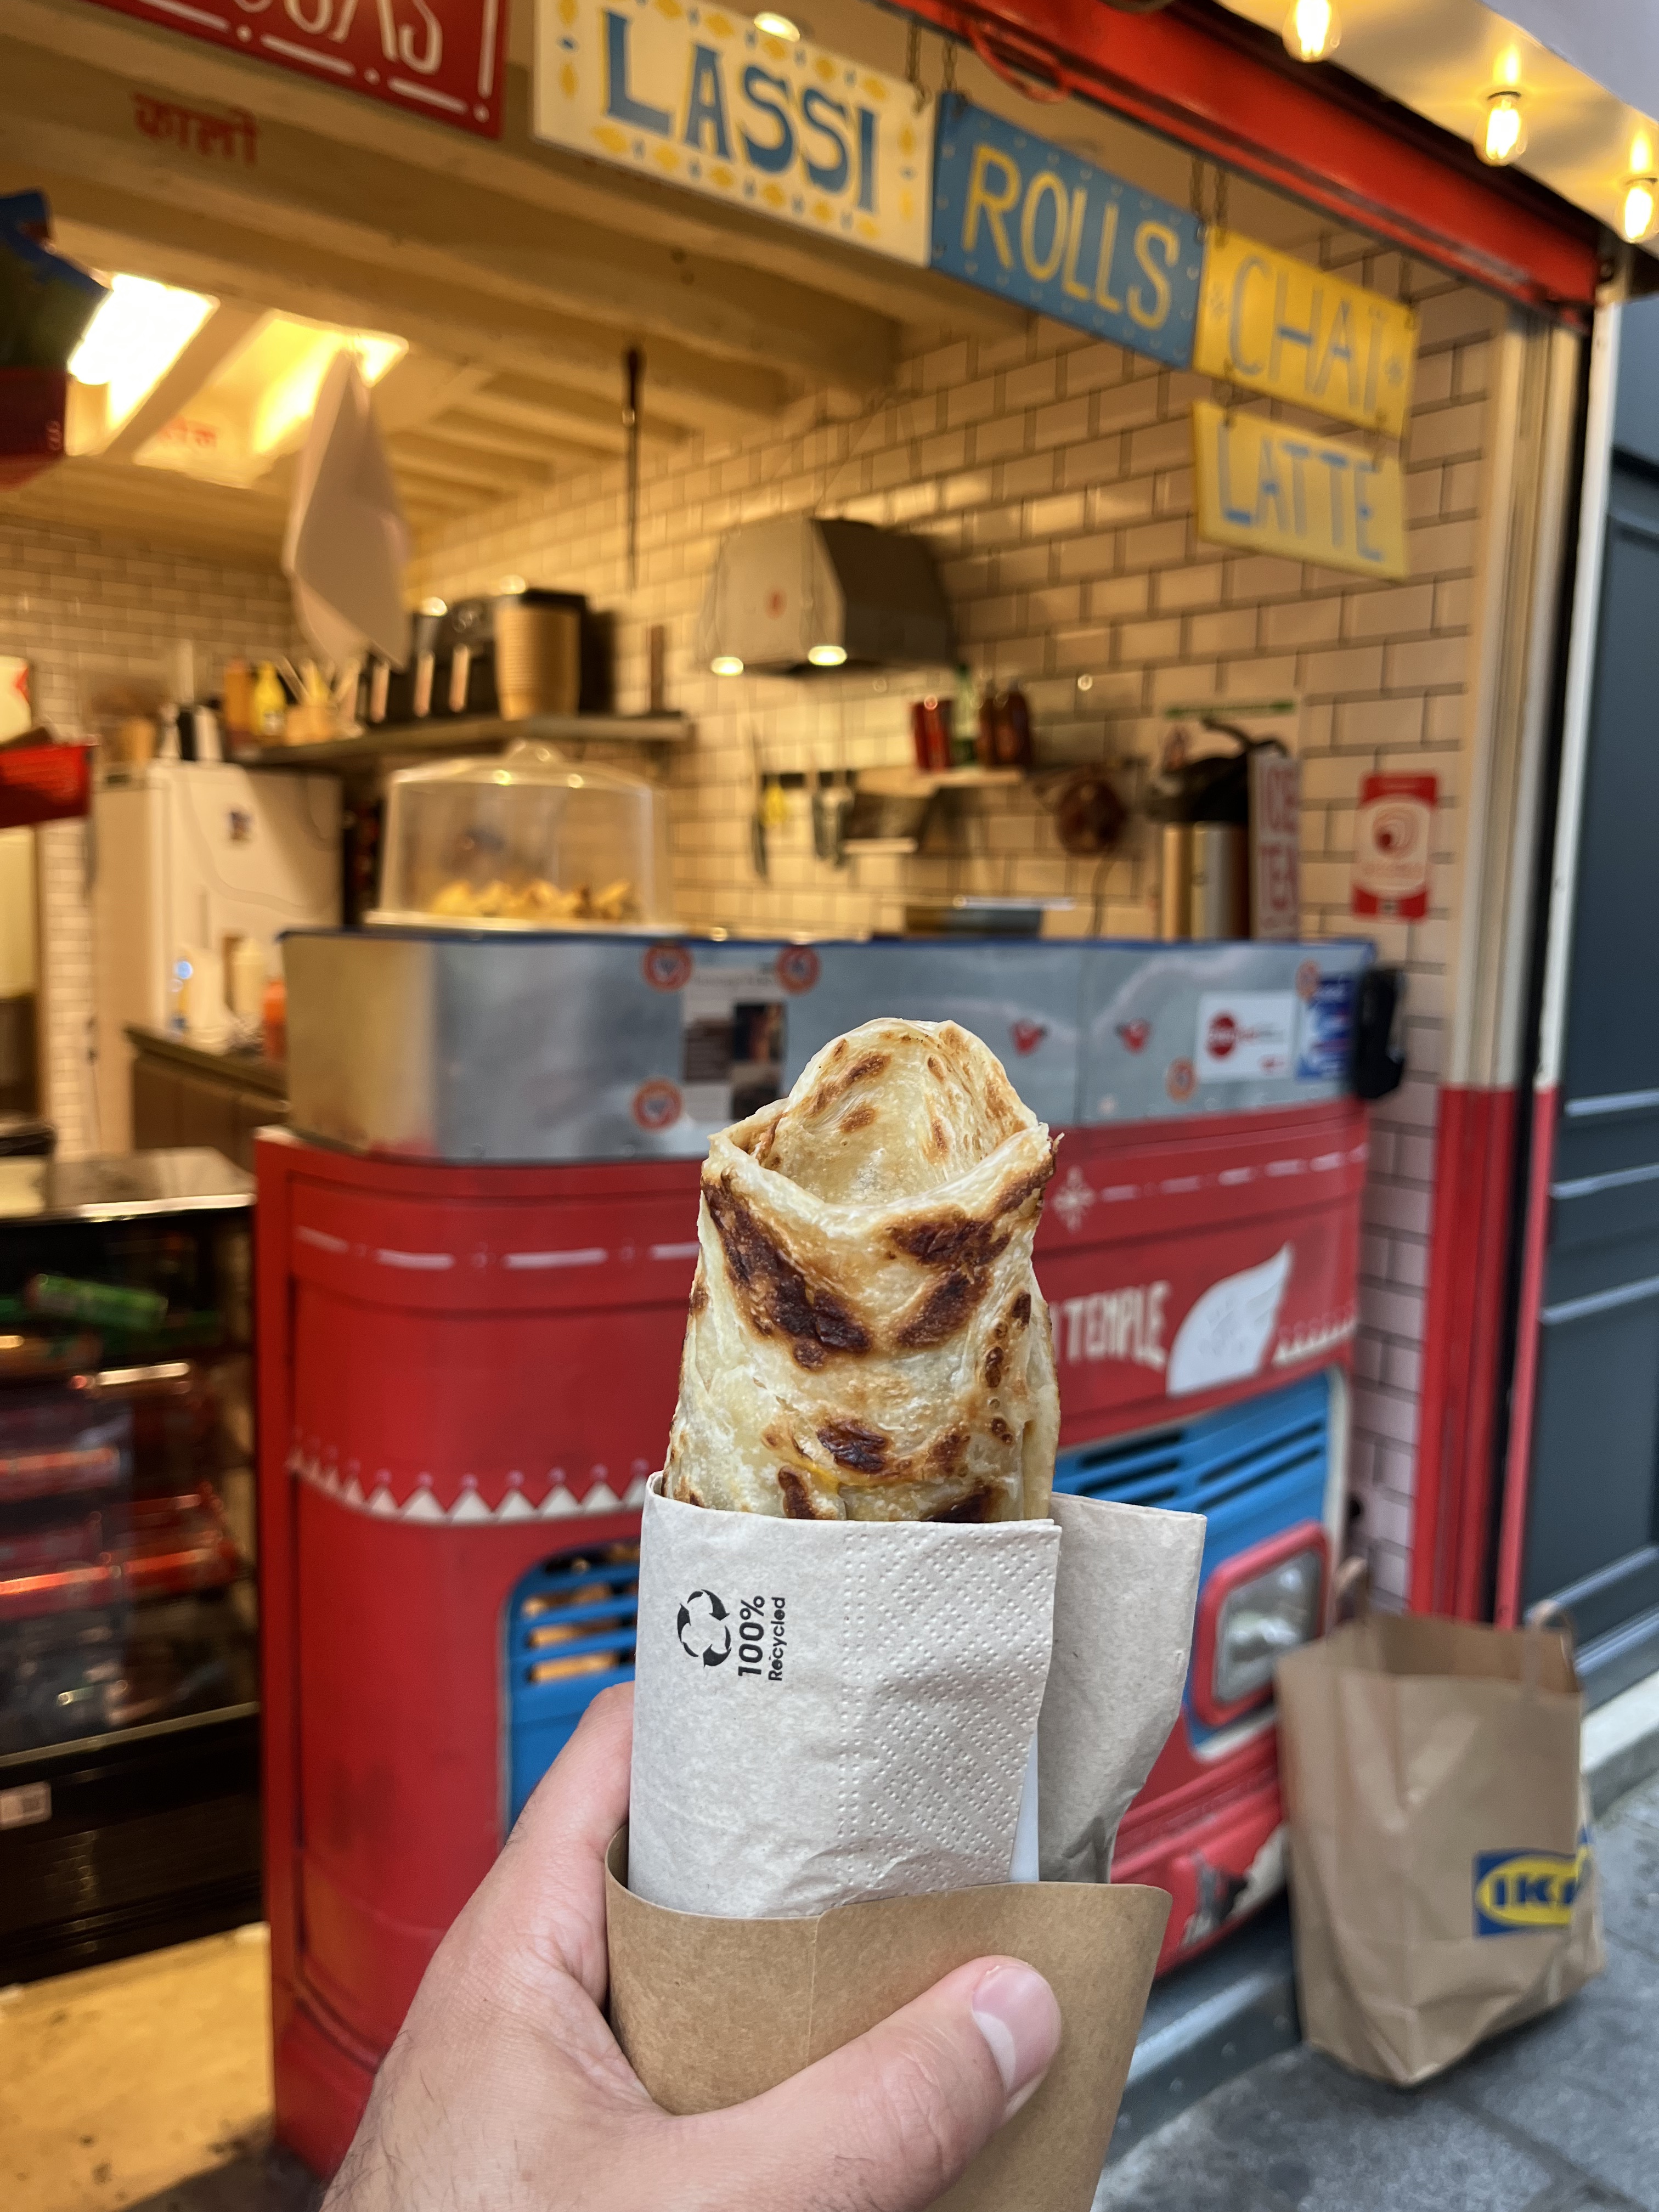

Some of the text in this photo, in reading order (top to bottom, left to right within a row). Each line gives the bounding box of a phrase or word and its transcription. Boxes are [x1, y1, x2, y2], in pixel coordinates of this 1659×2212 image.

[600, 8, 878, 214] LASSI
[962, 144, 1180, 330] ROLLS
[1217, 424, 1384, 563] LATTE
[1062, 1280, 1171, 1372] TEMPLE
[738, 1595, 765, 1677] 100%
[768, 1596, 787, 1681] Recycled
